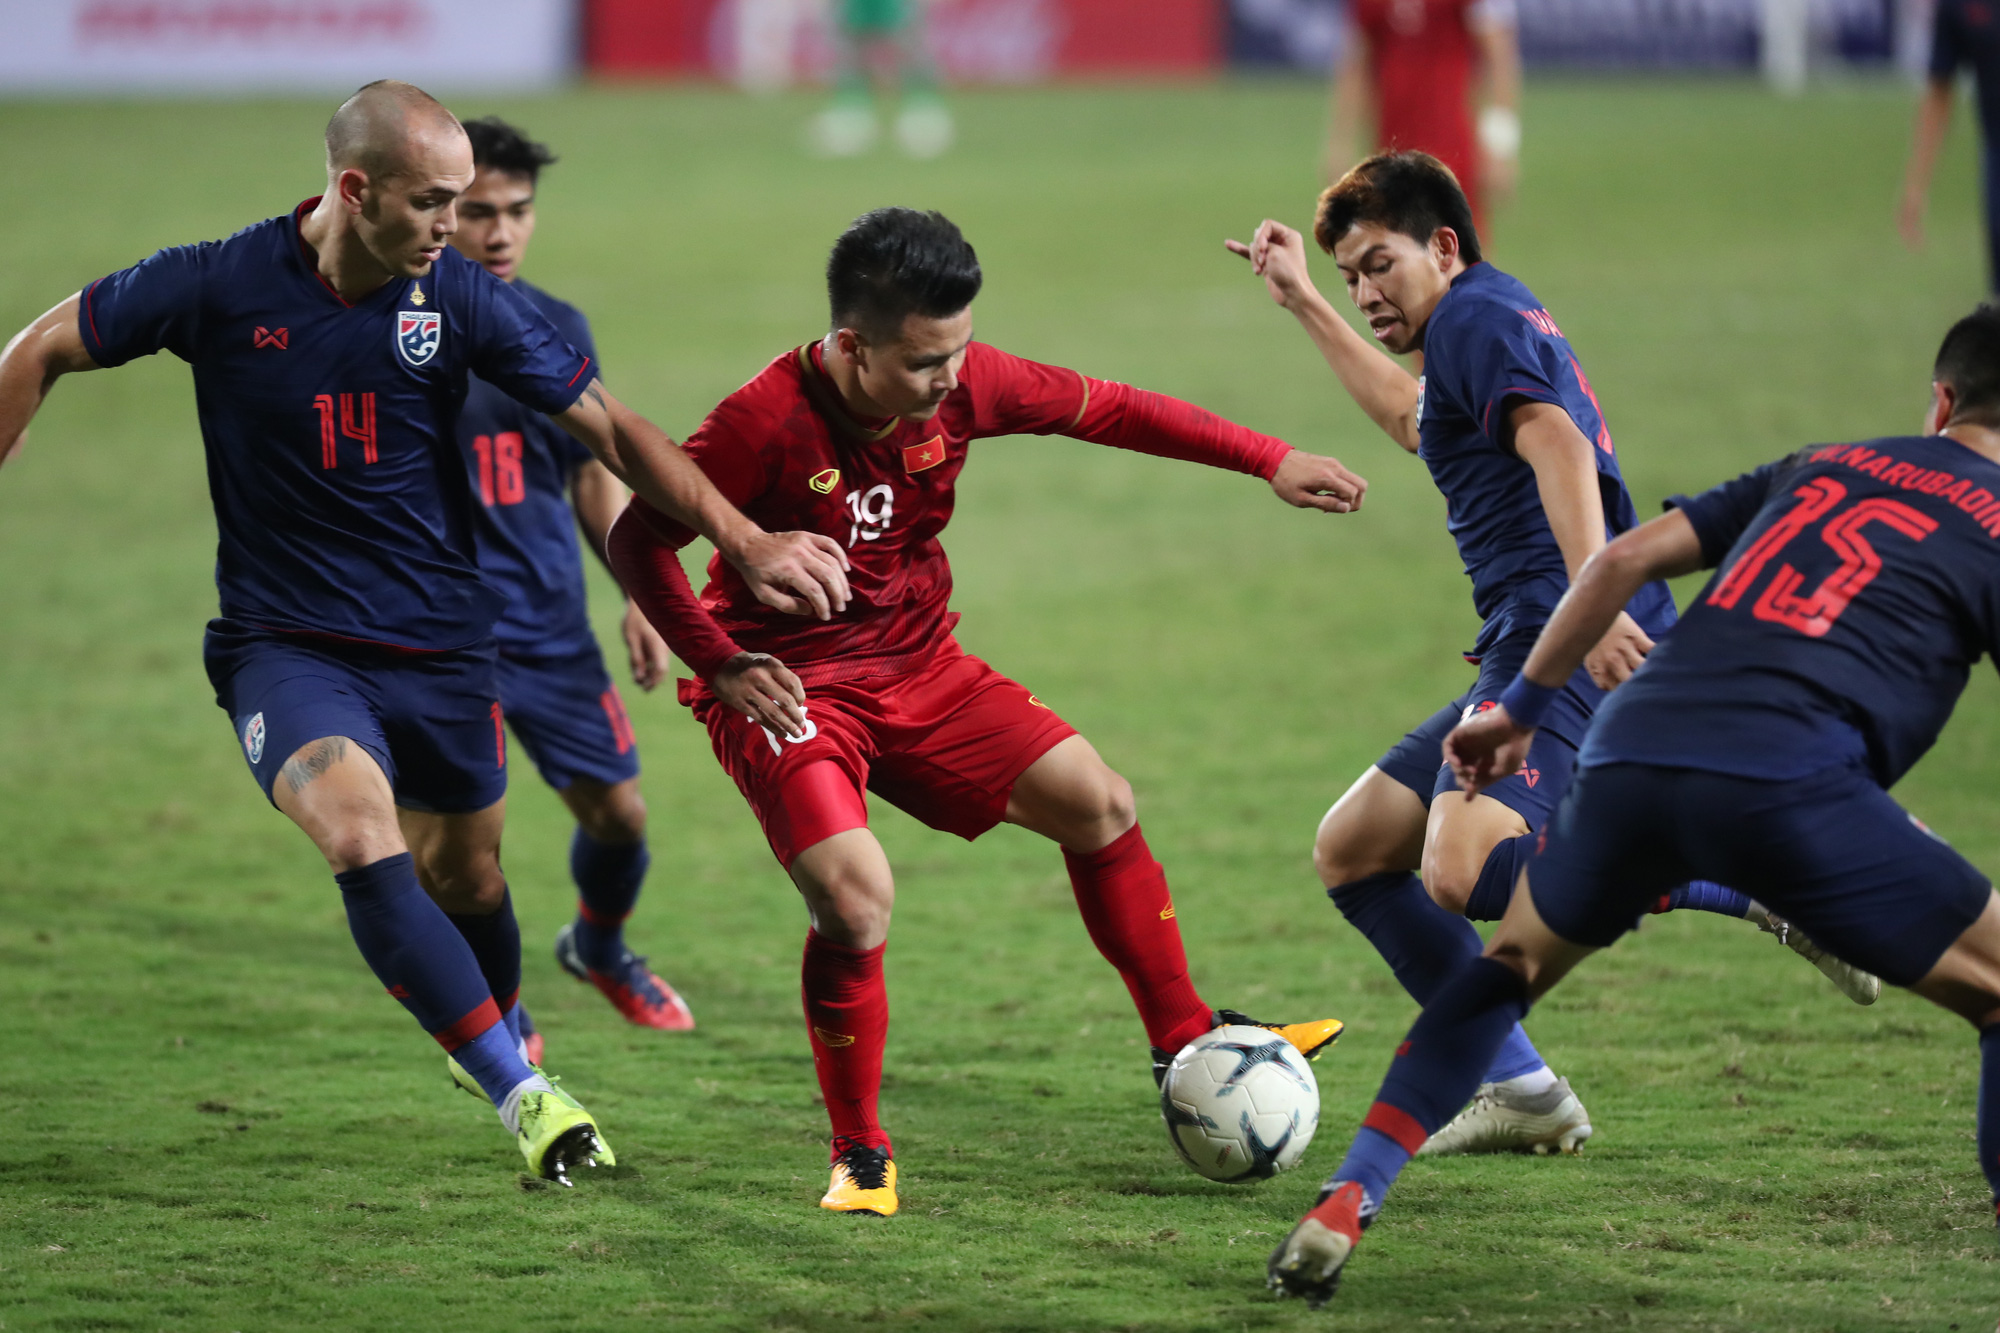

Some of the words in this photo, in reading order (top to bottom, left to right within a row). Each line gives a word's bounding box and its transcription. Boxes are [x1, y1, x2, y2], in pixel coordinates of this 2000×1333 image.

[313, 392, 378, 469] 14
[472, 430, 526, 507] 18
[846, 484, 895, 549] 19
[1705, 476, 1940, 637] 15
